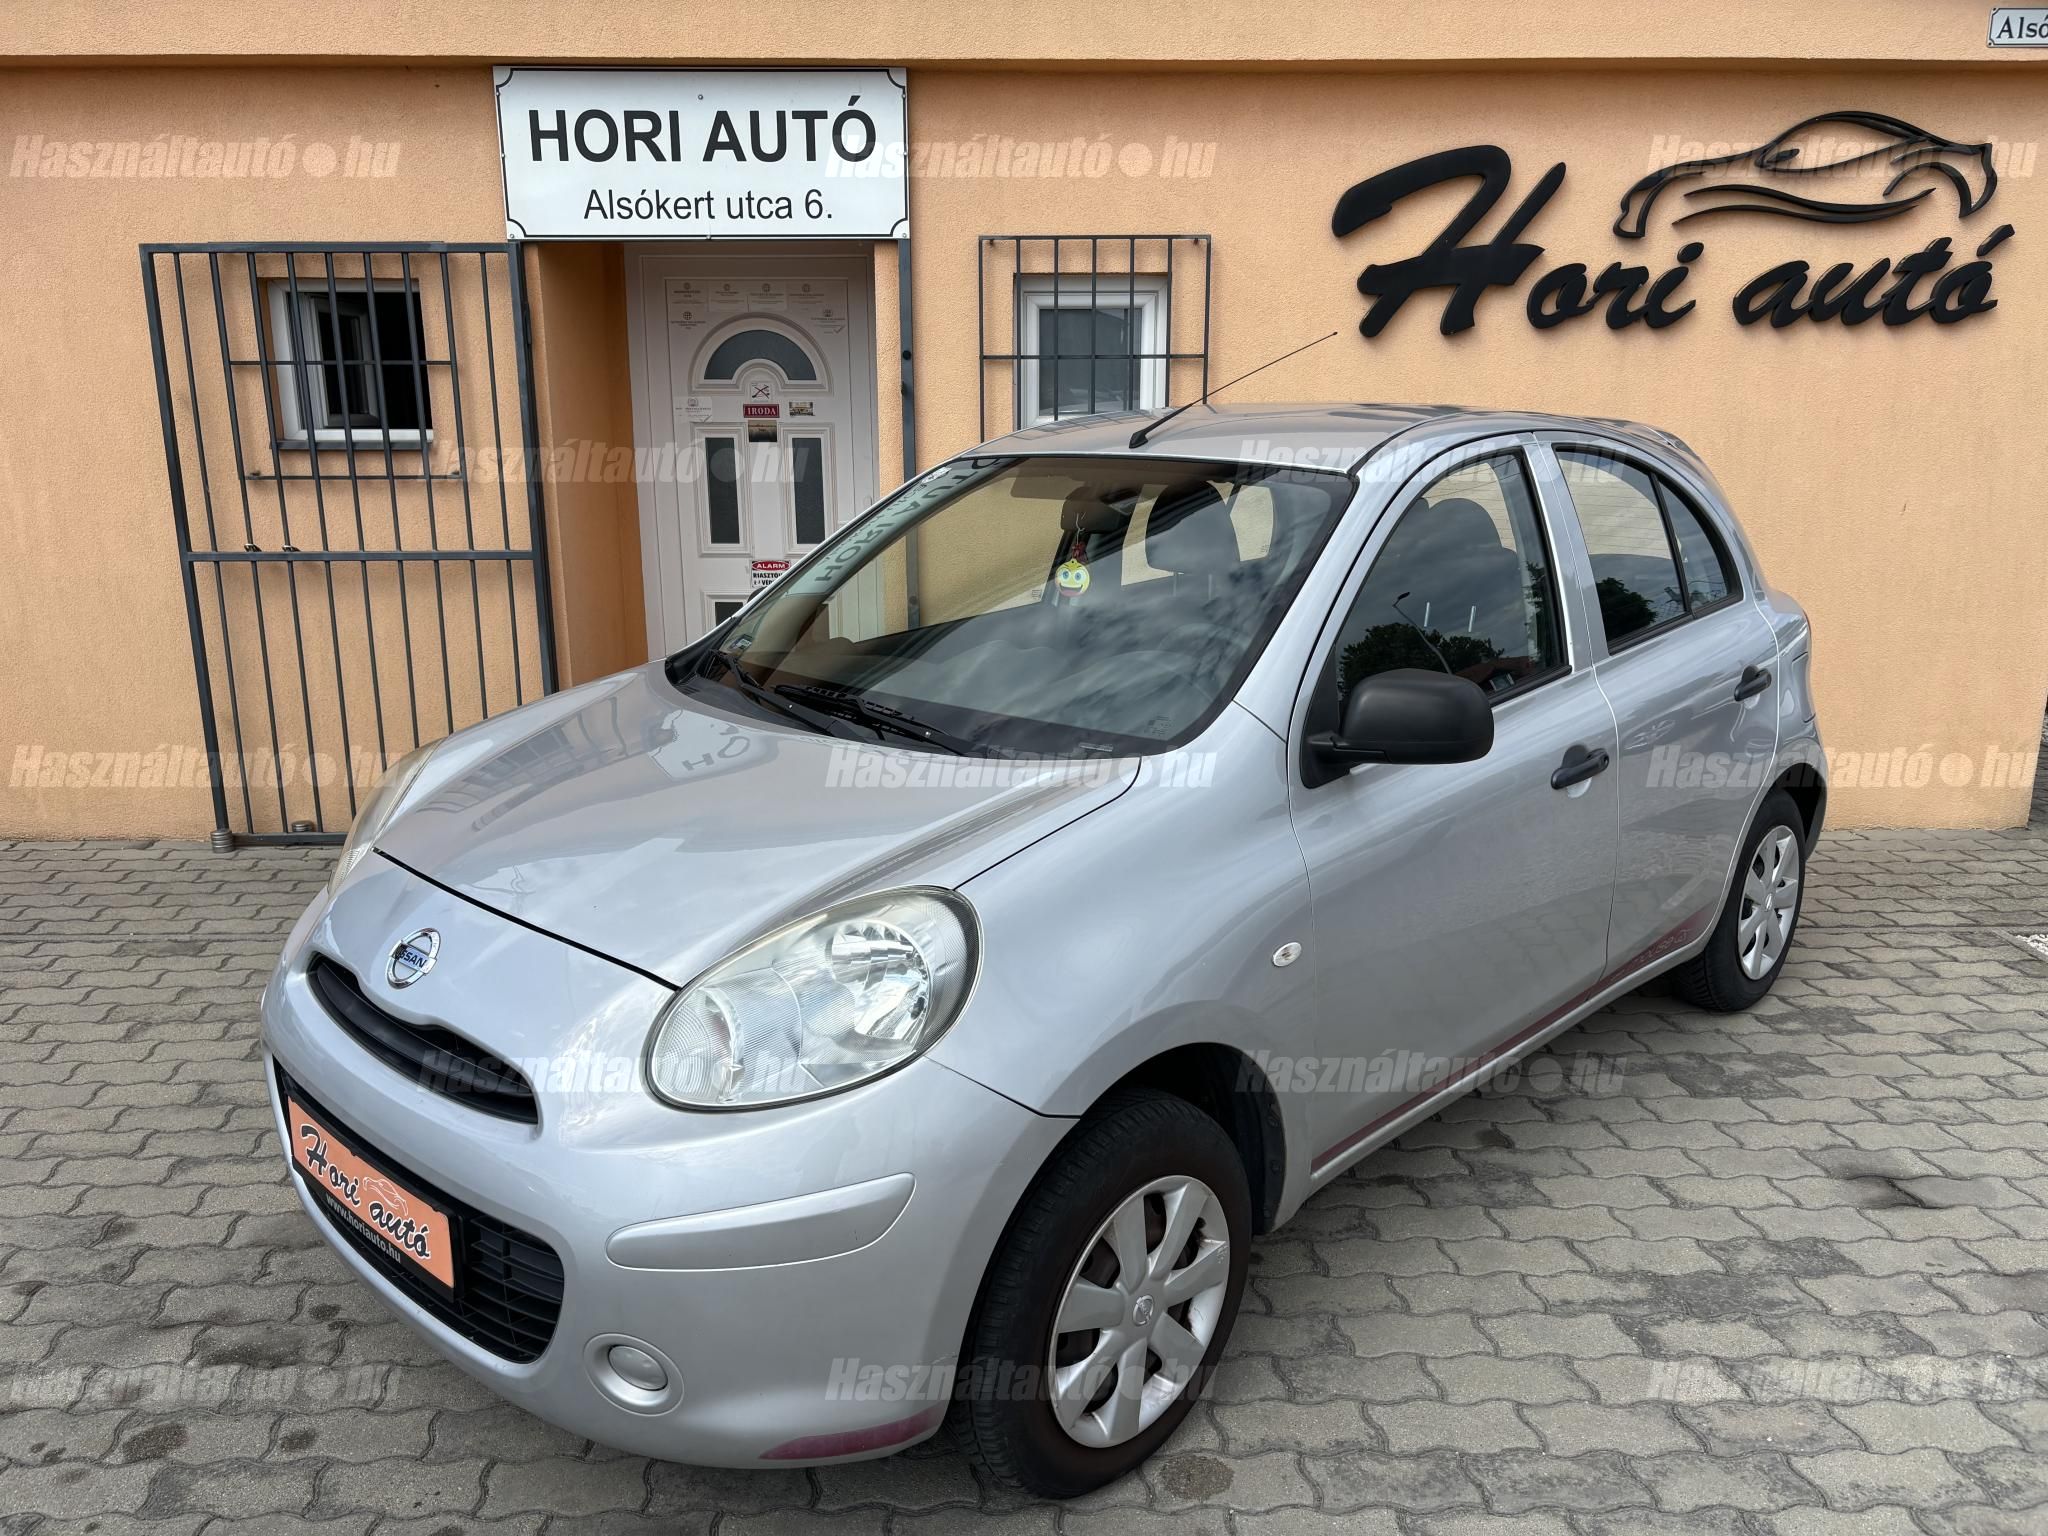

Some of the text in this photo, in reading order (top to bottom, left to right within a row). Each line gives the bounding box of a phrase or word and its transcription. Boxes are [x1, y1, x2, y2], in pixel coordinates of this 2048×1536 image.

[528, 95, 876, 162] HORI AUTÓ
[584, 188, 832, 219] Alsókert utca 6.
[1332, 145, 2014, 338] Hori autó
[747, 407, 777, 415] IRODA
[301, 1124, 431, 1259] Hori autó
[326, 1191, 401, 1263] www.horiauto.hu
